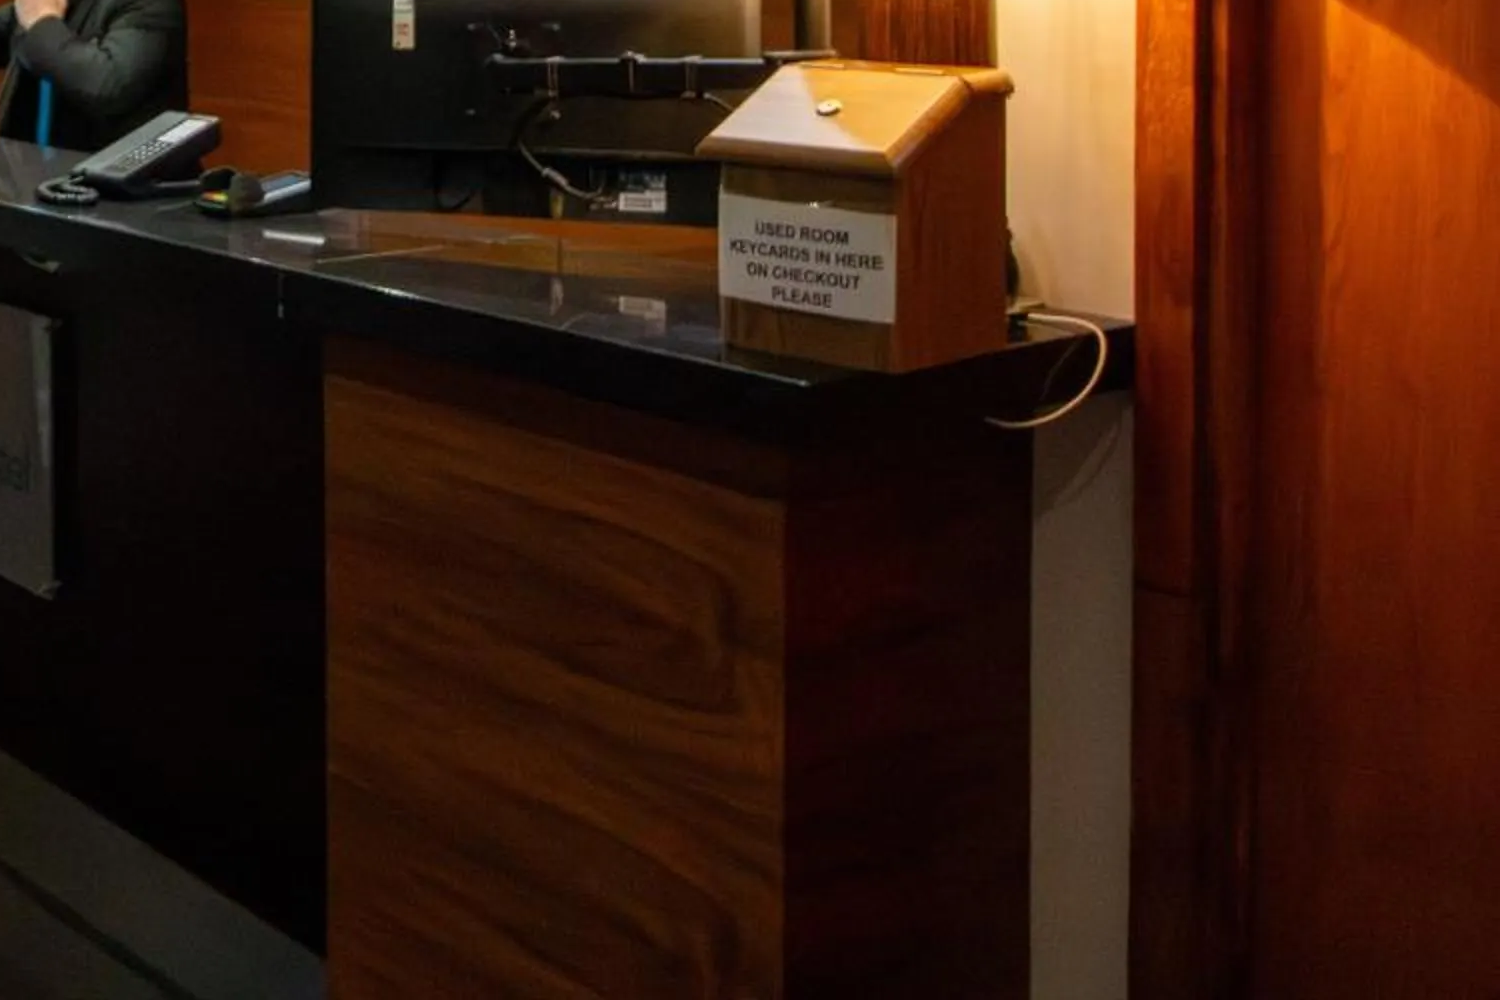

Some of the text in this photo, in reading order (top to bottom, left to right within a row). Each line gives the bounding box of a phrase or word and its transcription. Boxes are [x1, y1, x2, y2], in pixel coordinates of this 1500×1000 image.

[755, 220, 849, 245] USED ROOM
[730, 238, 884, 270] KEYCARDS IN HERE
[746, 262, 861, 290] ON CHECKOUT
[771, 285, 833, 308] PLEASE
